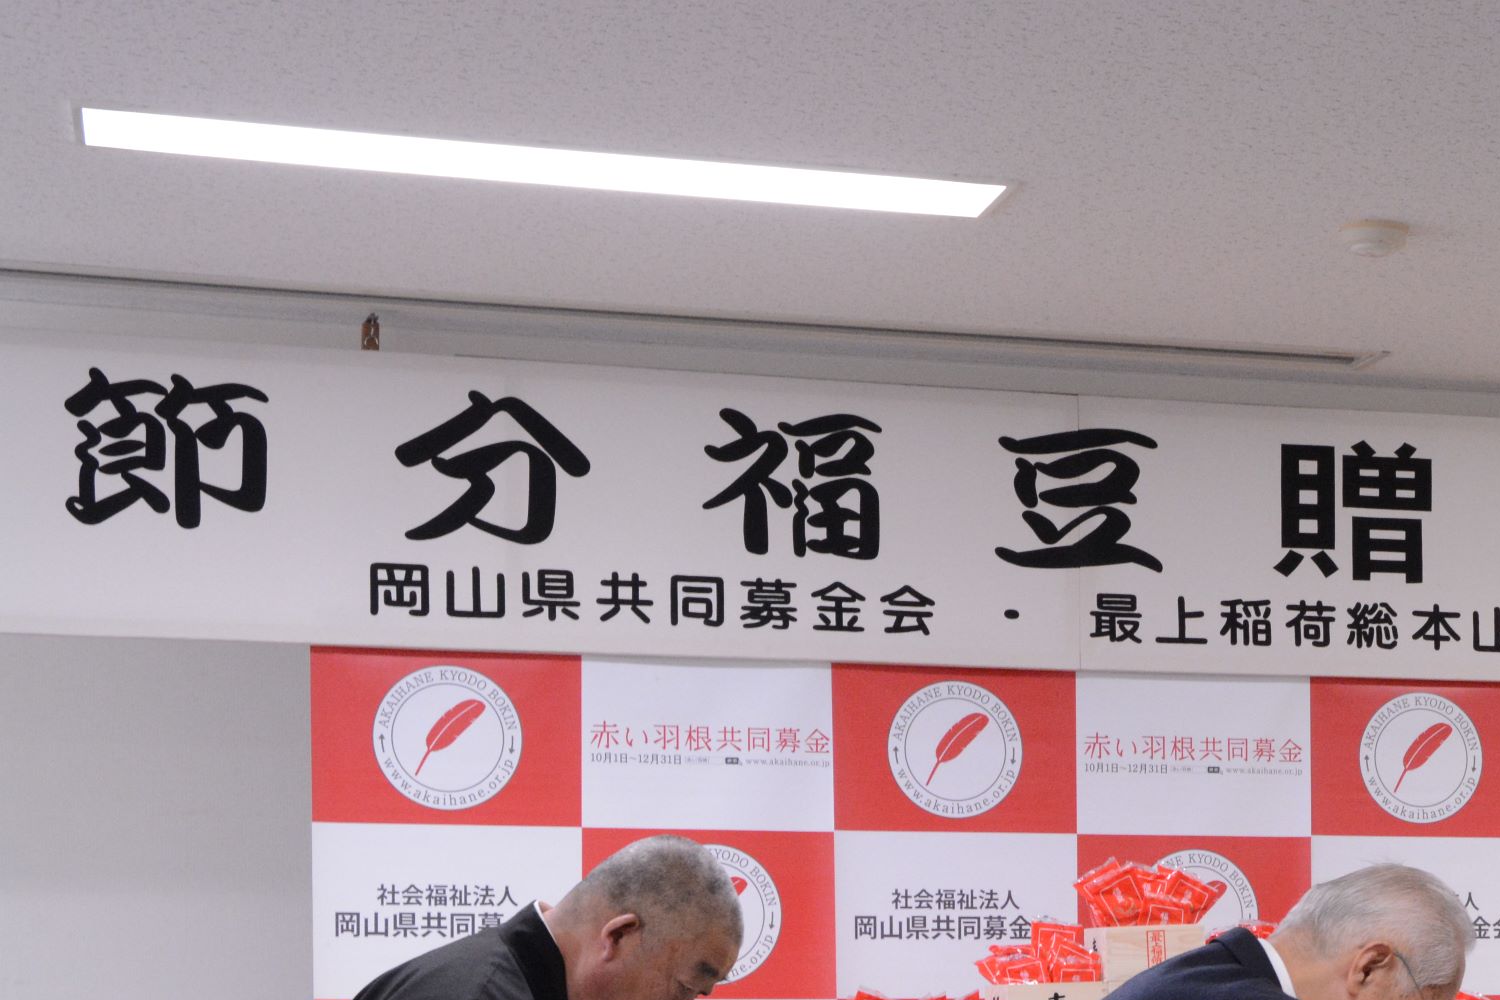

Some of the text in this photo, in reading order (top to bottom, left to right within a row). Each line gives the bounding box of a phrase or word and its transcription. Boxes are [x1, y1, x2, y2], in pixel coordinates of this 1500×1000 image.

[369, 562, 936, 636] 岡山県共同募金会
[378, 669, 518, 731] AKAIHANE KYODO BOKIN
[893, 685, 1018, 743] AKAIHANE KYODO BOKIN
[590, 720, 831, 755] 赤い羽根共同募金
[1364, 695, 1478, 751] AKAIHANE KYODO BOKIN
[1083, 731, 1304, 763] 赤い羽根共同募金
[383, 757, 515, 807] www.akaihane.or.jp
[897, 768, 1016, 815] www.akaihane.or.jp
[1368, 776, 1476, 820] www.akaihane.or.jp
[376, 883, 519, 907] 社会福祉法人
[749, 866, 777, 907] BOKIN
[891, 888, 1021, 910] 社会福祉法人
[1188, 853, 1254, 909] KYODO BOKIN
[854, 914, 1032, 940] 岡山県共同募金
